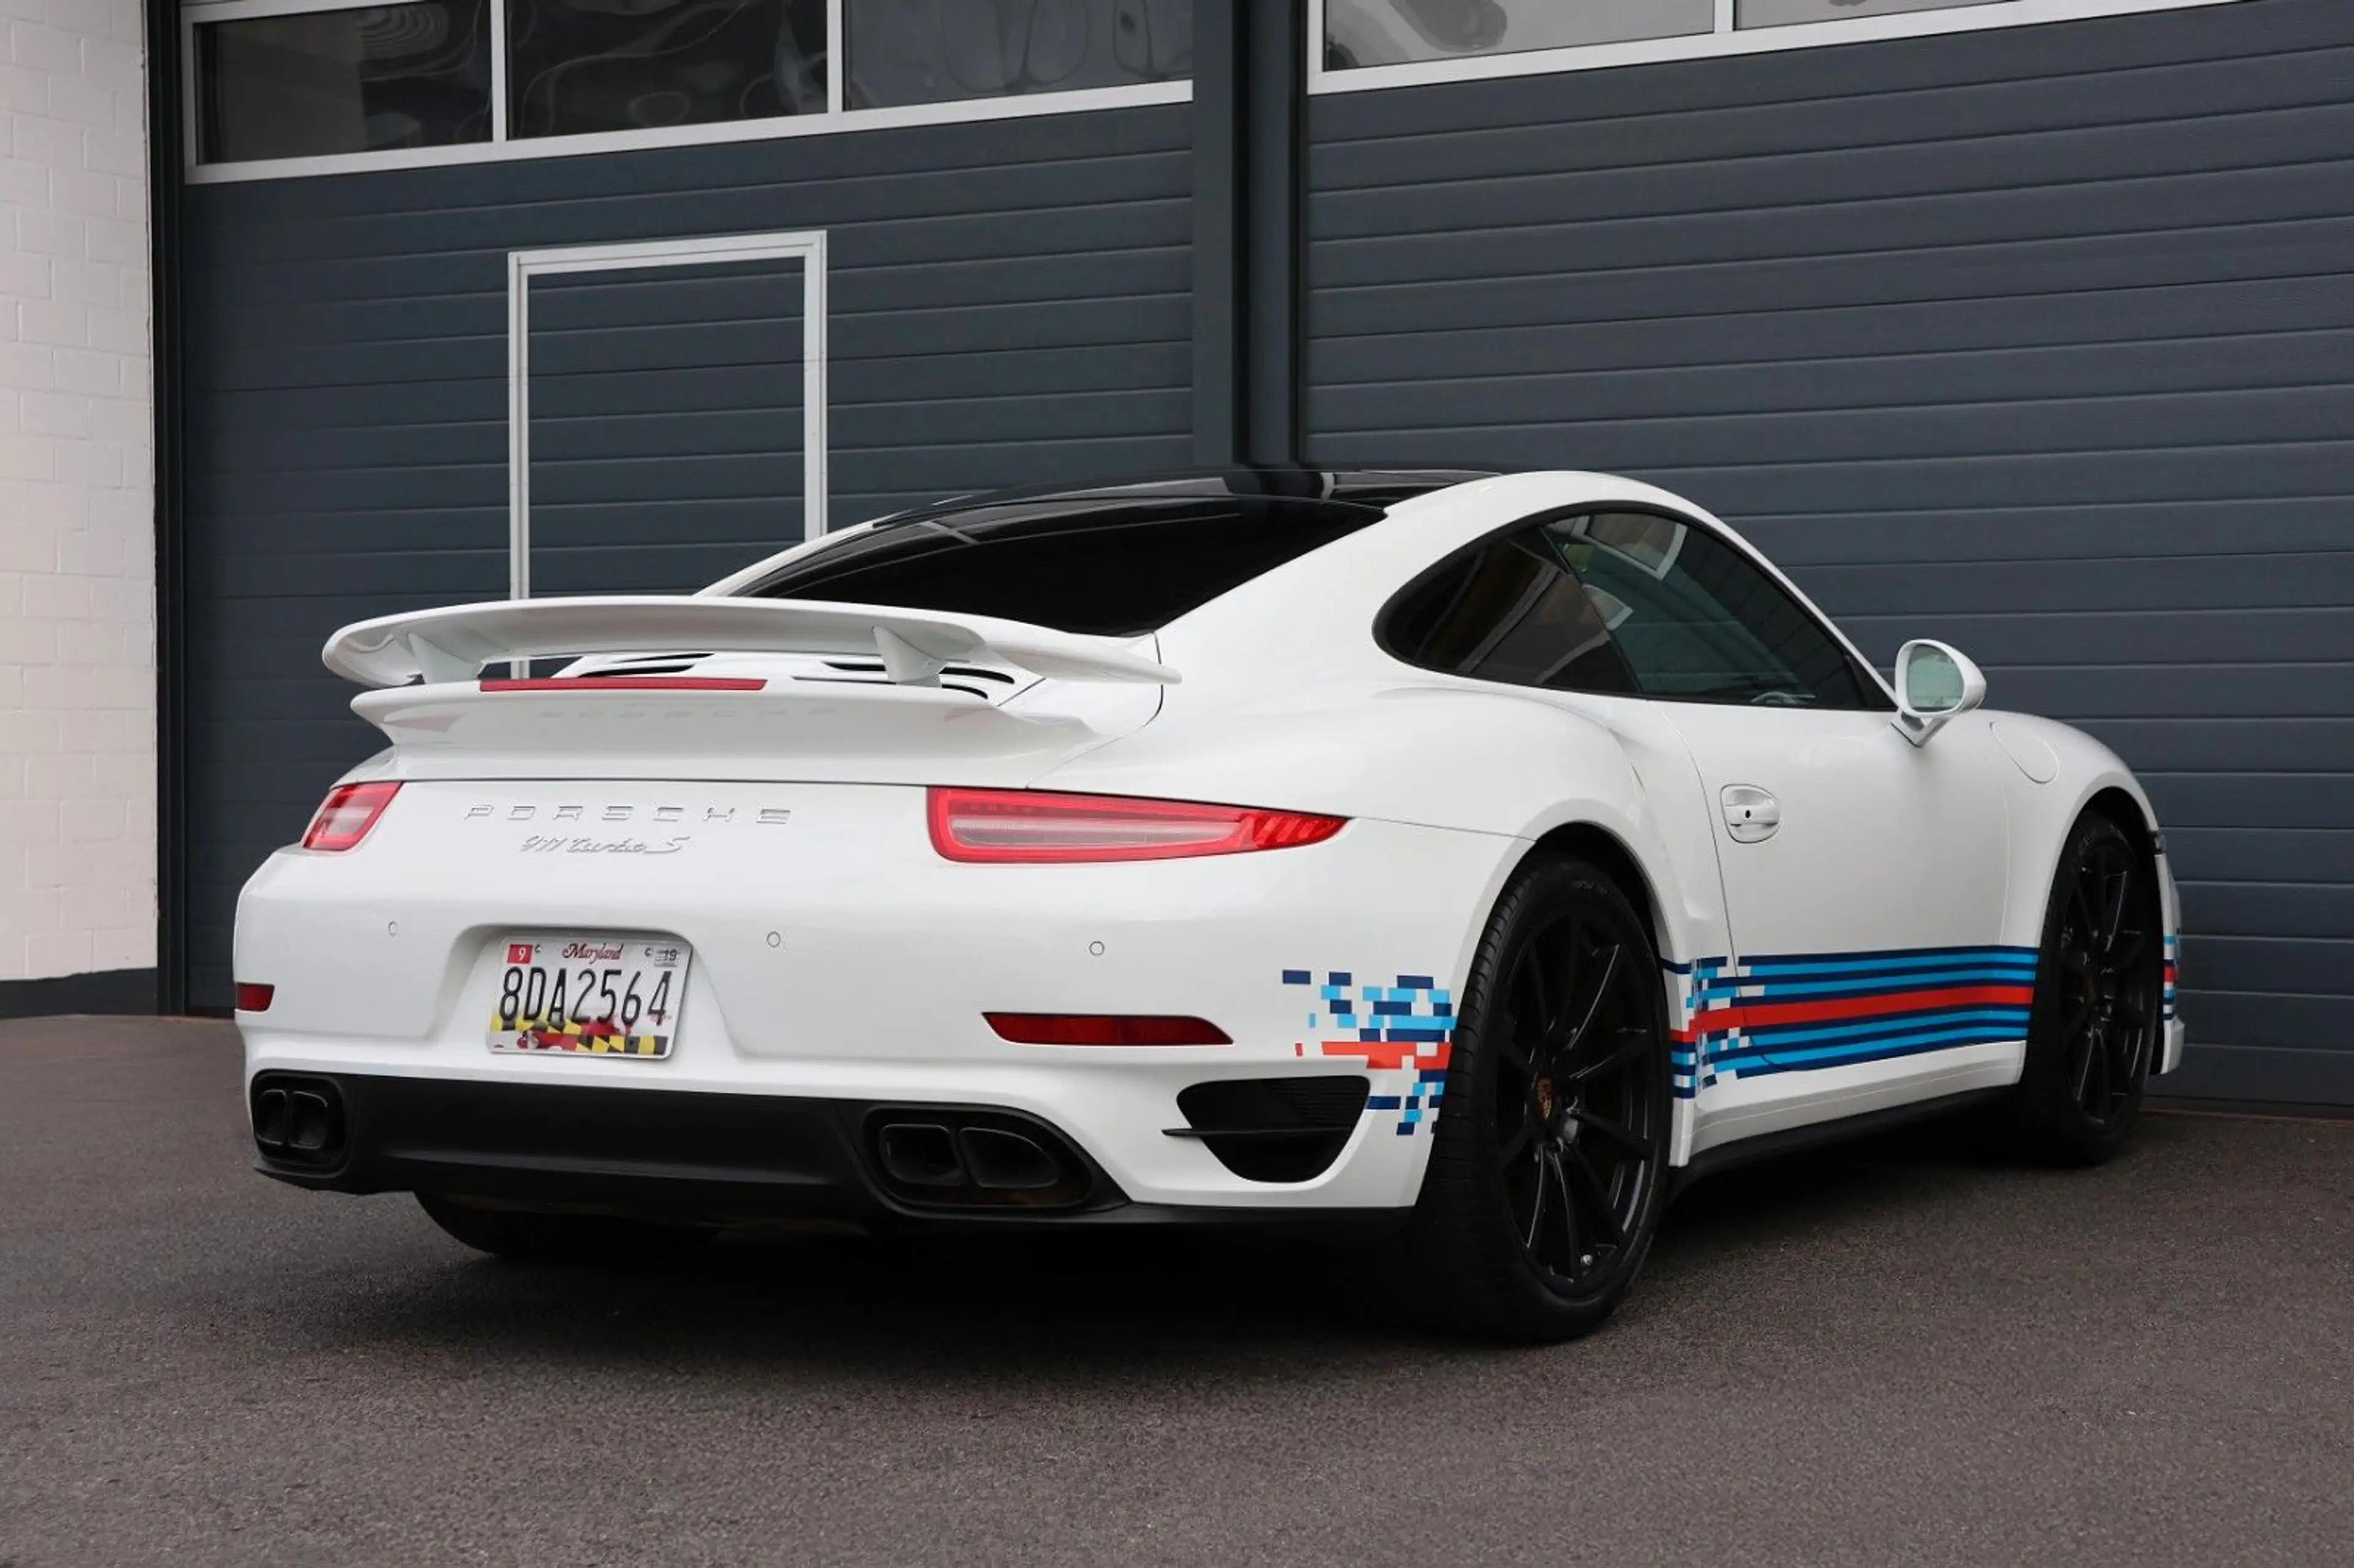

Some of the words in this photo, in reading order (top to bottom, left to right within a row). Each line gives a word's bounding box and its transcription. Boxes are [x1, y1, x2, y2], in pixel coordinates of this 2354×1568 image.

[464, 804, 791, 824] PORSCHE
[520, 835, 567, 853] 911
[644, 835, 691, 854] S
[563, 943, 623, 964] Maryland
[499, 965, 672, 1026] 8DA2564
